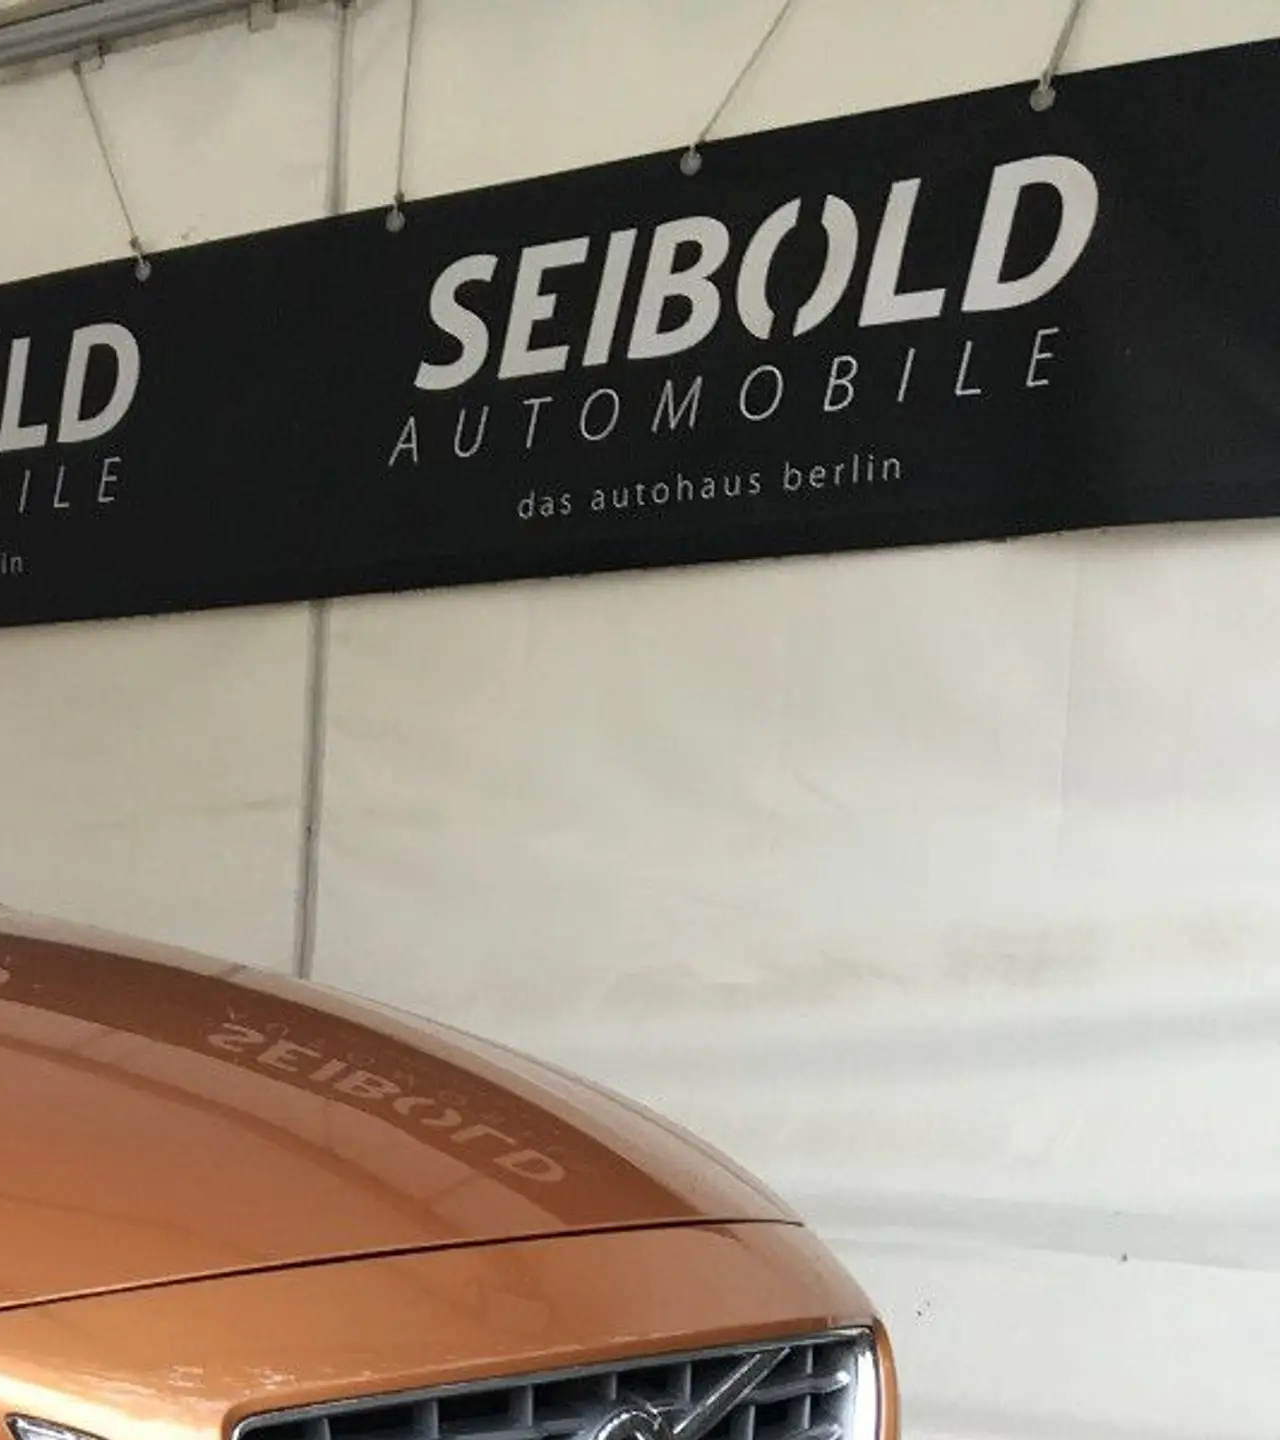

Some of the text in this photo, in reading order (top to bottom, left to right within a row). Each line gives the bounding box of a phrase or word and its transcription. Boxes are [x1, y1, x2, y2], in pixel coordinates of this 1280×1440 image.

[413, 154, 1099, 391] SEIBOLD
[388, 327, 1060, 467] AUTOMOBILE
[517, 453, 903, 520] das autohaus berlin
